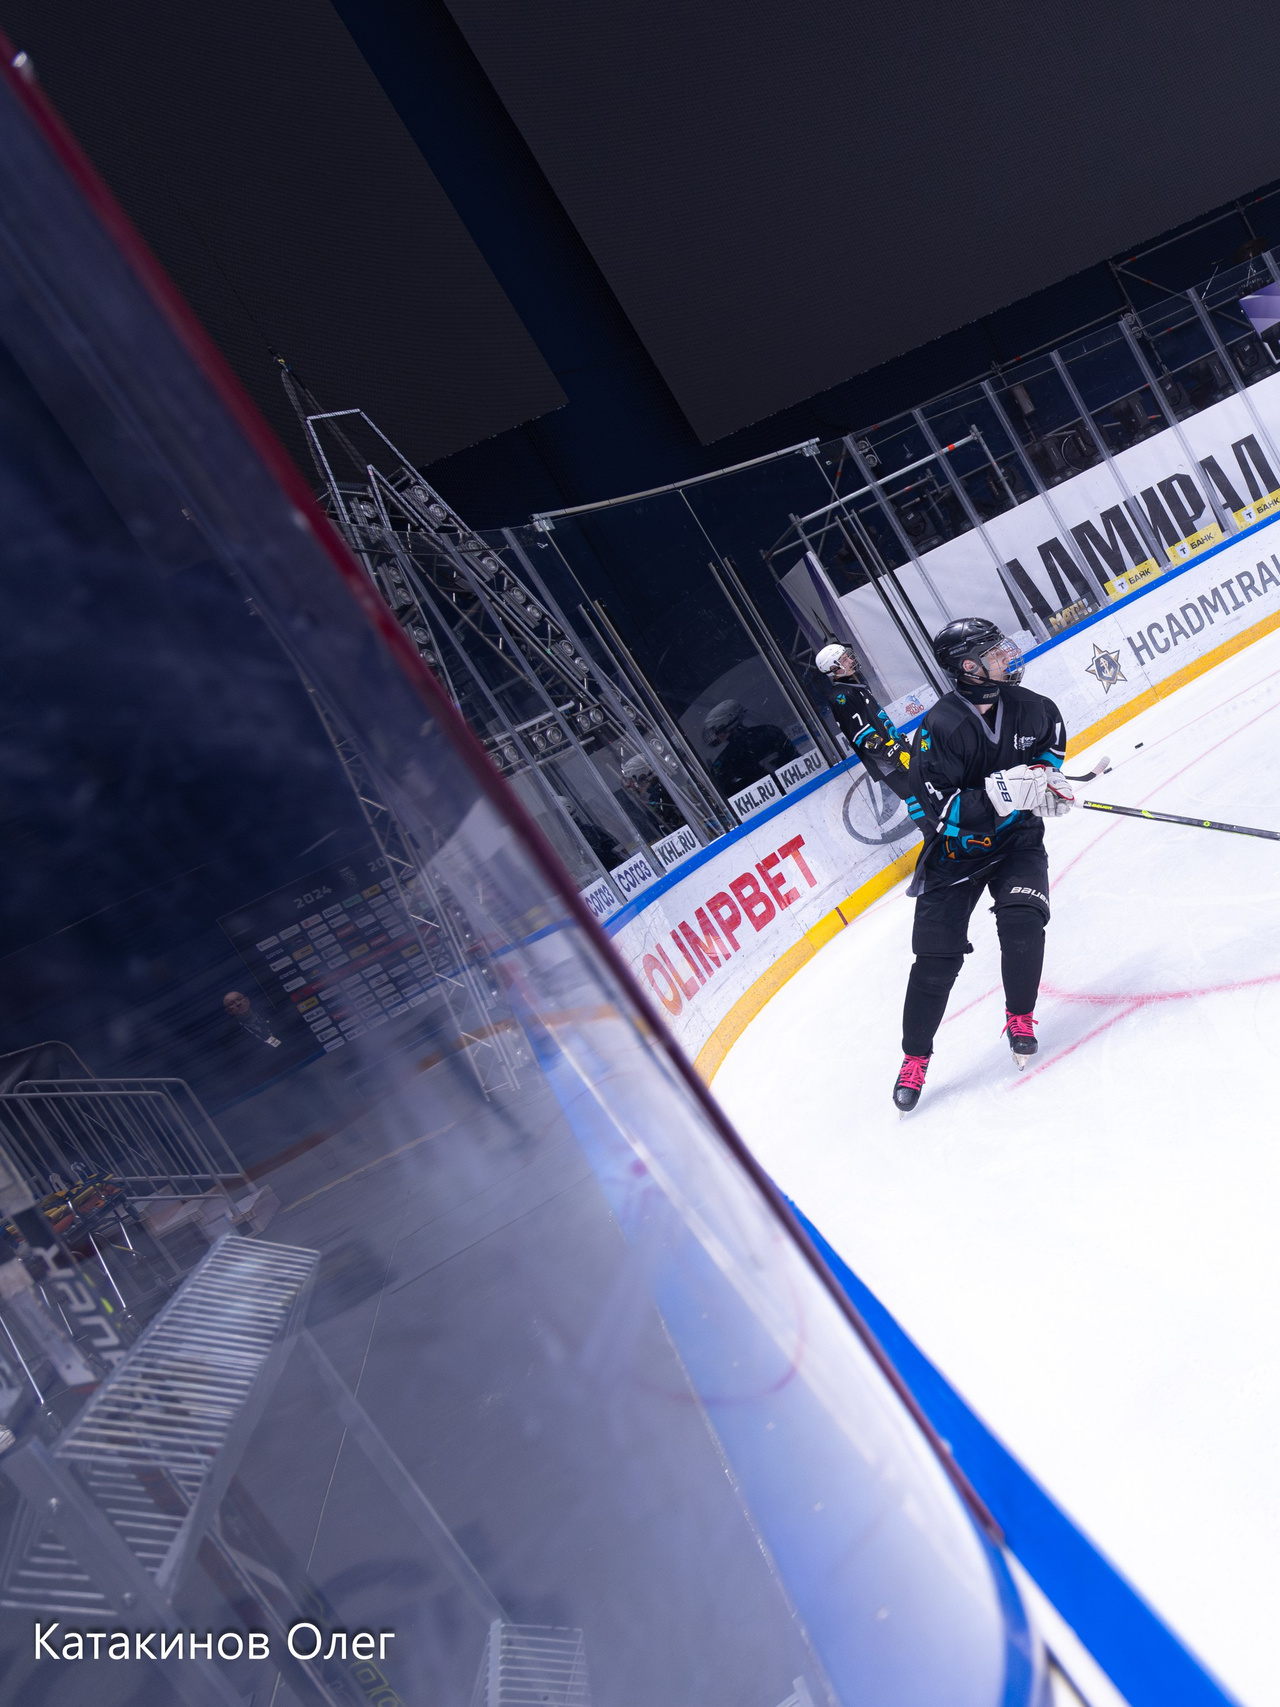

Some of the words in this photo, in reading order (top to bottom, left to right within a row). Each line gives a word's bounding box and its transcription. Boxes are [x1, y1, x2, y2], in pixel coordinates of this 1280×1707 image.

[1256, 496, 1280, 515] БАНК
[1189, 532, 1215, 550] БАНК
[1128, 566, 1152, 585] БАНК
[852, 712, 864, 727] 7
[781, 752, 823, 789] KHL.RU
[734, 781, 776, 817] KHL.RU
[657, 829, 697, 867] KHL.RU
[642, 833, 818, 1017] OLIMPBET
